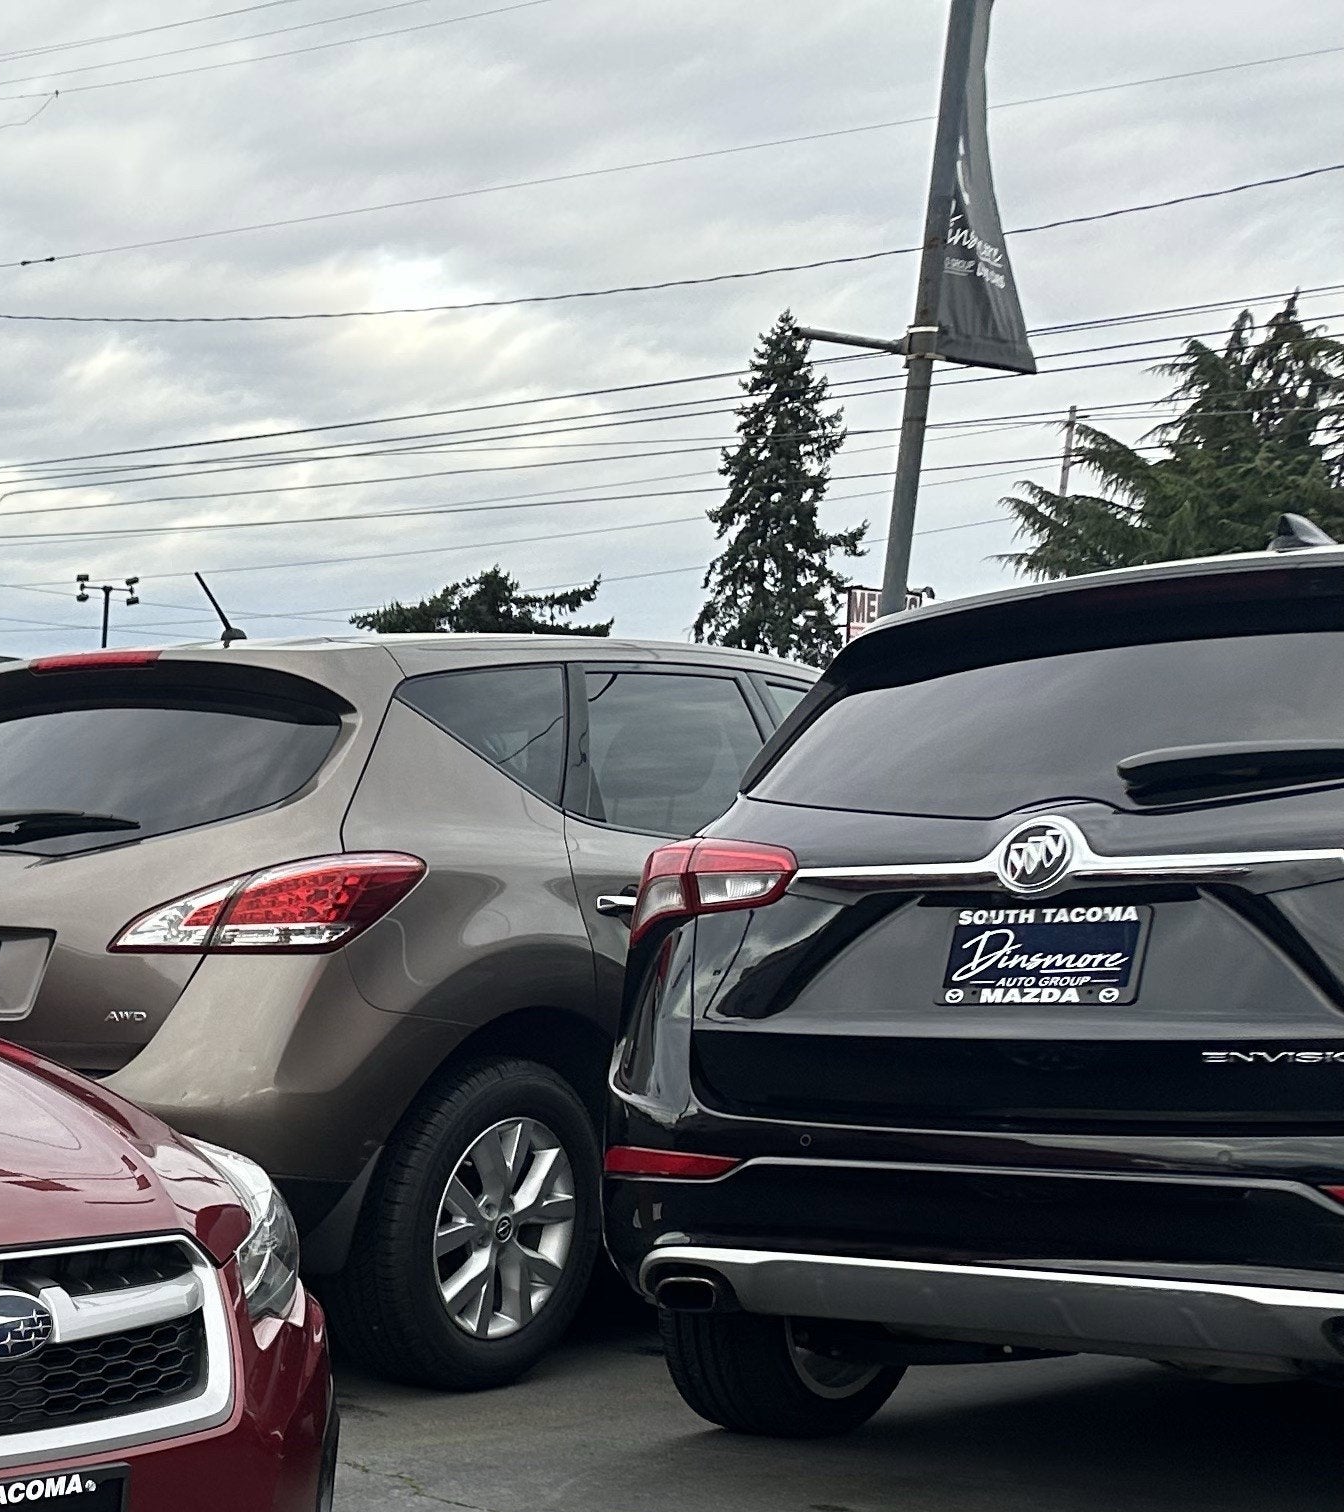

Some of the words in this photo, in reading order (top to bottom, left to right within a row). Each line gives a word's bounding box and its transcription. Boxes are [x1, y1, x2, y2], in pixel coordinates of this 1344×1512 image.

[958, 908, 1036, 926] SOUTH
[1042, 906, 1139, 924] TACOMA
[952, 929, 1129, 982] Dinsmore
[996, 977, 1036, 987] AUTO
[1038, 976, 1092, 987] GROUP
[979, 988, 1081, 1004] MAZDA
[104, 1010, 147, 1021] AWD
